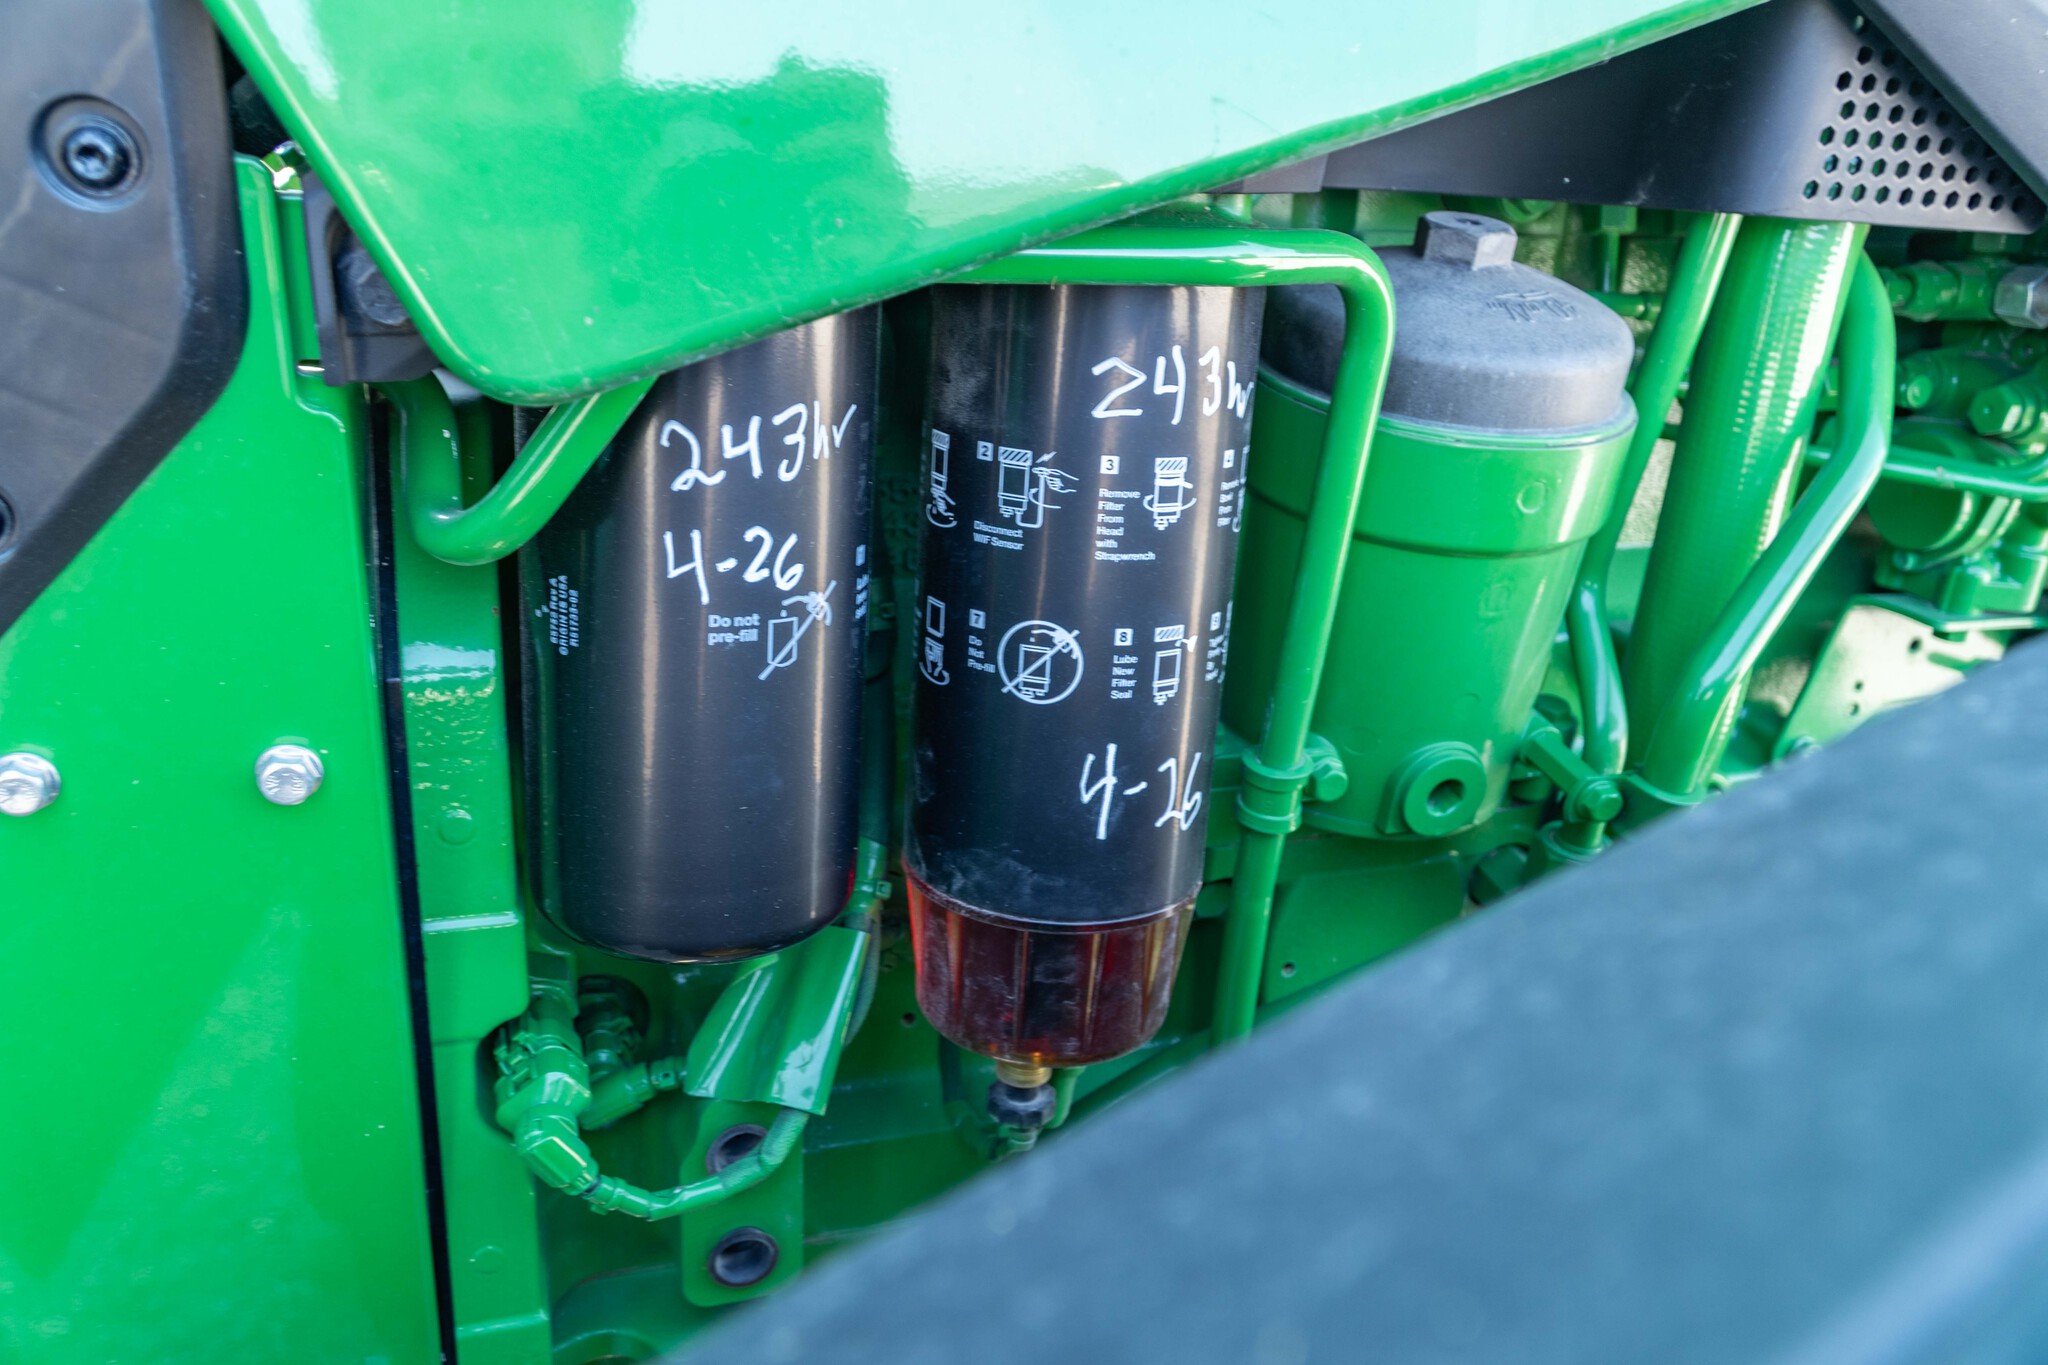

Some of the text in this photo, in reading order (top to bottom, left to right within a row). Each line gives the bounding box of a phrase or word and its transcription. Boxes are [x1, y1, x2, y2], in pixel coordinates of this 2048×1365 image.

[659, 400, 858, 492] 243hr
[1098, 488, 1142, 499] Remove
[1097, 500, 1126, 511] Filter
[1096, 513, 1125, 524] From
[973, 520, 1024, 538] Disconnect
[1095, 525, 1125, 536] Head
[990, 536, 1025, 551] Sensor
[1094, 538, 1119, 549] with
[1093, 550, 1157, 563] Strapwrench
[663, 525, 805, 606] 4-26
[708, 613, 760, 628] Do not
[707, 628, 759, 646] pre-fill
[968, 634, 983, 647] Do
[968, 646, 985, 659] Not
[1112, 654, 1139, 664] Lube
[967, 658, 996, 674] Pre-fill
[1112, 666, 1136, 676] New
[1111, 678, 1138, 688] Filter
[1109, 689, 1133, 700] Seal
[1079, 742, 1203, 841] 4-26
